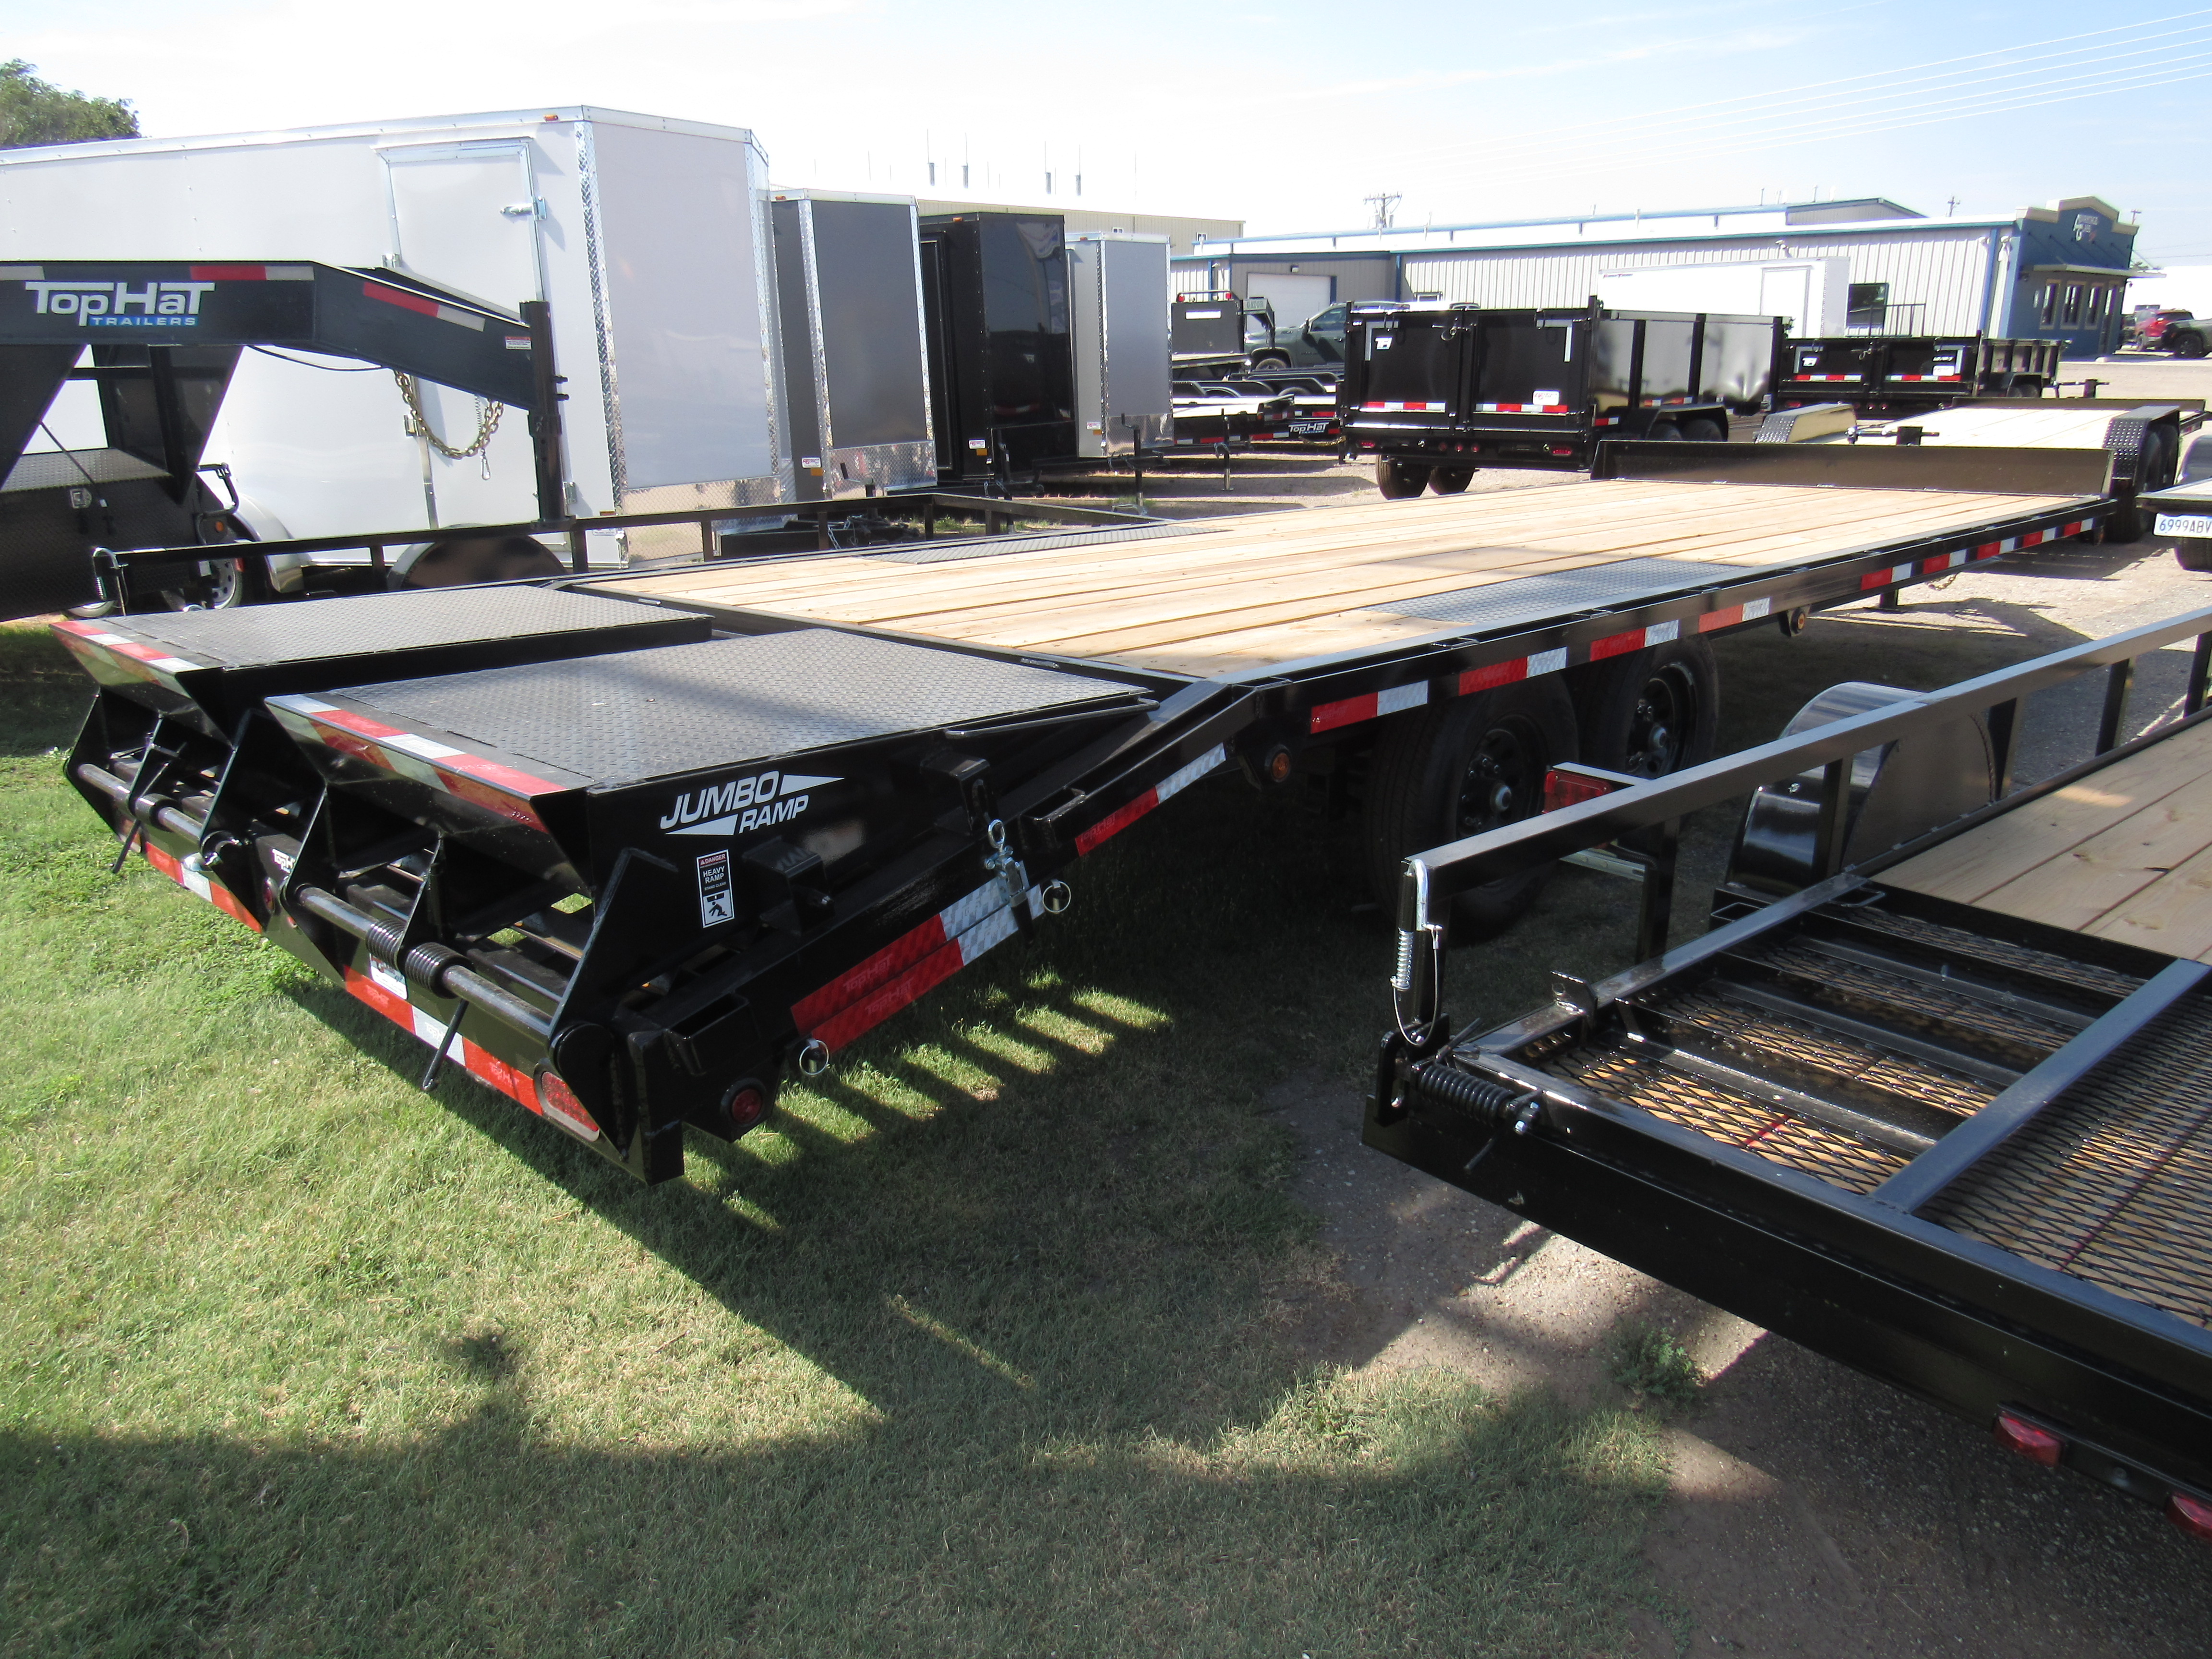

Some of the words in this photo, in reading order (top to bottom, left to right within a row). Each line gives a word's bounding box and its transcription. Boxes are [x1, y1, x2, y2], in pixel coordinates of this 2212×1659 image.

[92, 317, 196, 325] TRAILERS
[660, 770, 780, 830] JUMBO
[738, 794, 809, 834] RAMP
[705, 854, 726, 864] DANGER
[703, 866, 725, 878] HEAVY
[705, 873, 724, 883] RAMP
